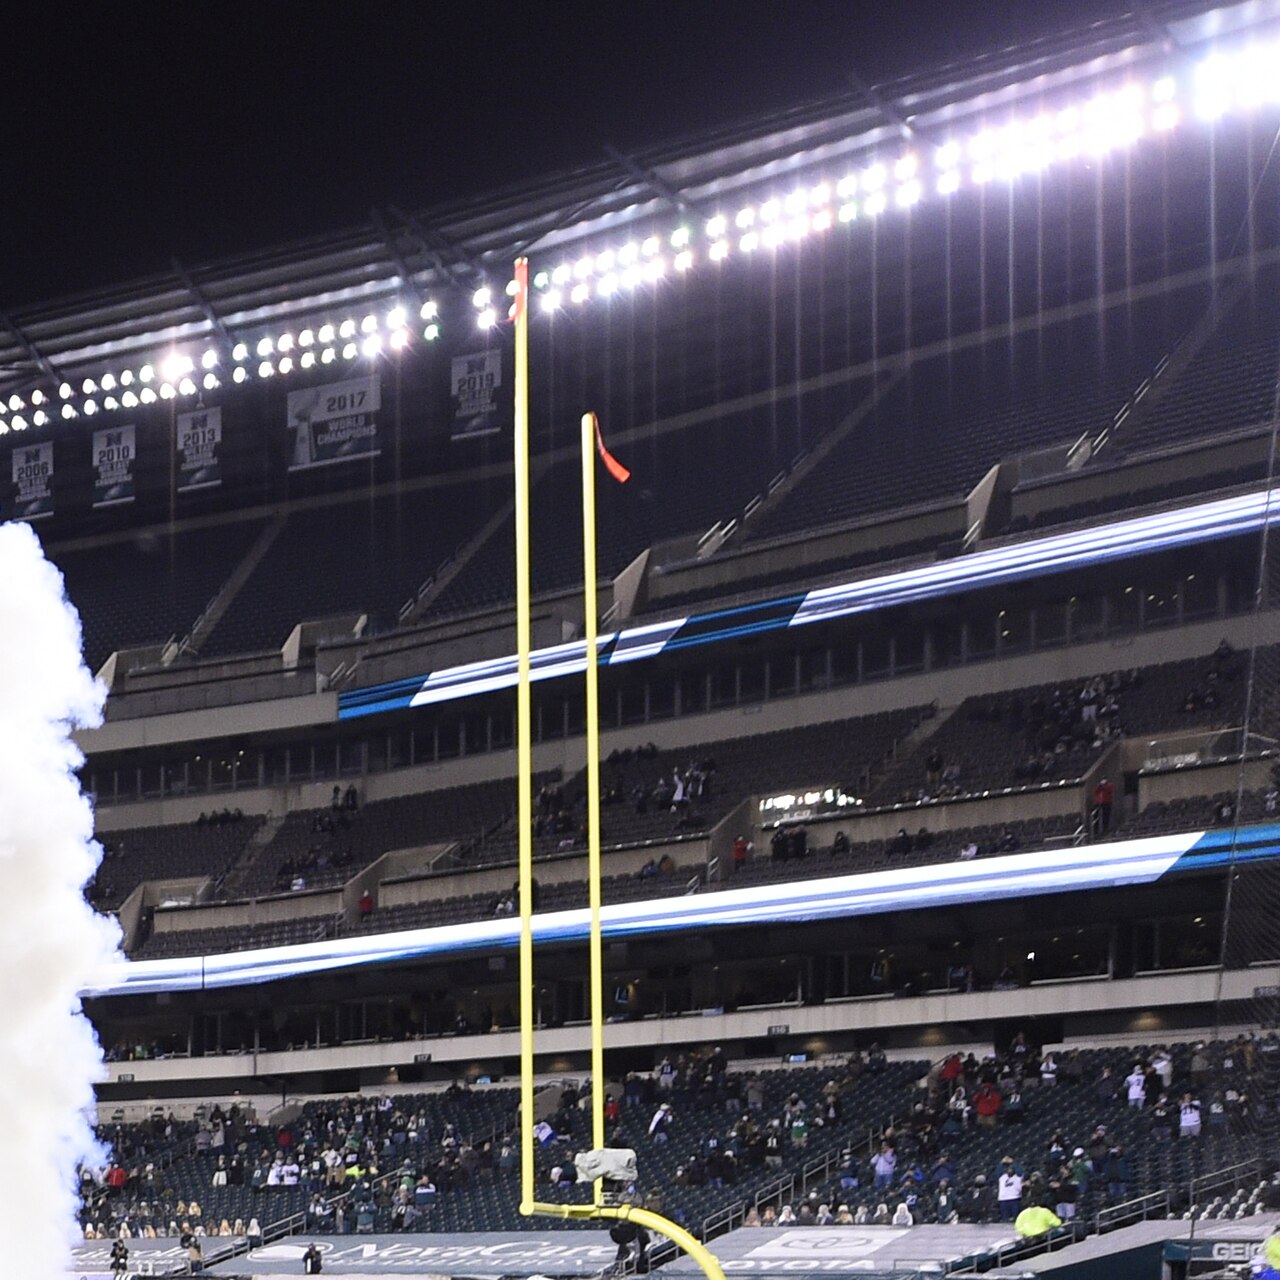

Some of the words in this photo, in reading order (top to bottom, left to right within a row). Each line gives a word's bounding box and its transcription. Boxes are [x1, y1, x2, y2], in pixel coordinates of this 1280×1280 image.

[326, 391, 367, 413] 2017
[183, 430, 216, 447] 2013
[316, 424, 377, 446] CHAMPIONS
[98, 445, 130, 463] 2010
[17, 461, 49, 480] 2006
[720, 1260, 876, 1270] OYOTA
